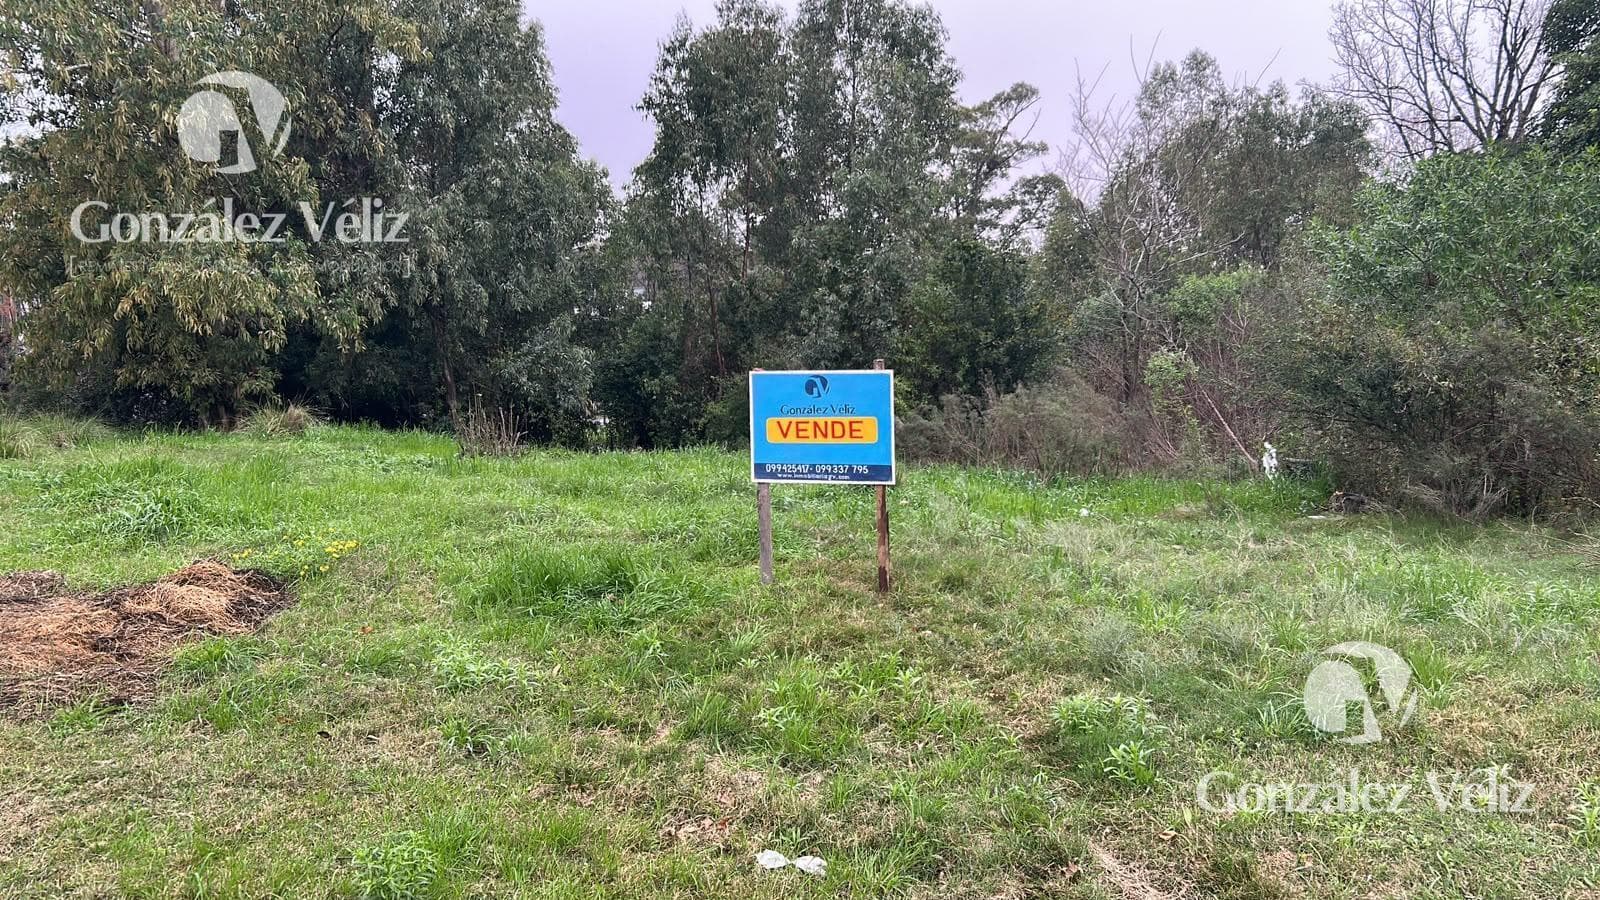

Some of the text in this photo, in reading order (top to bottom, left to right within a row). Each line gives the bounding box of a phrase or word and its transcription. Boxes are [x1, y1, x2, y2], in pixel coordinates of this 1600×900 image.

[780, 403, 856, 415] González Véliz
[776, 420, 864, 440] VENDE
[852, 465, 869, 474] 795
